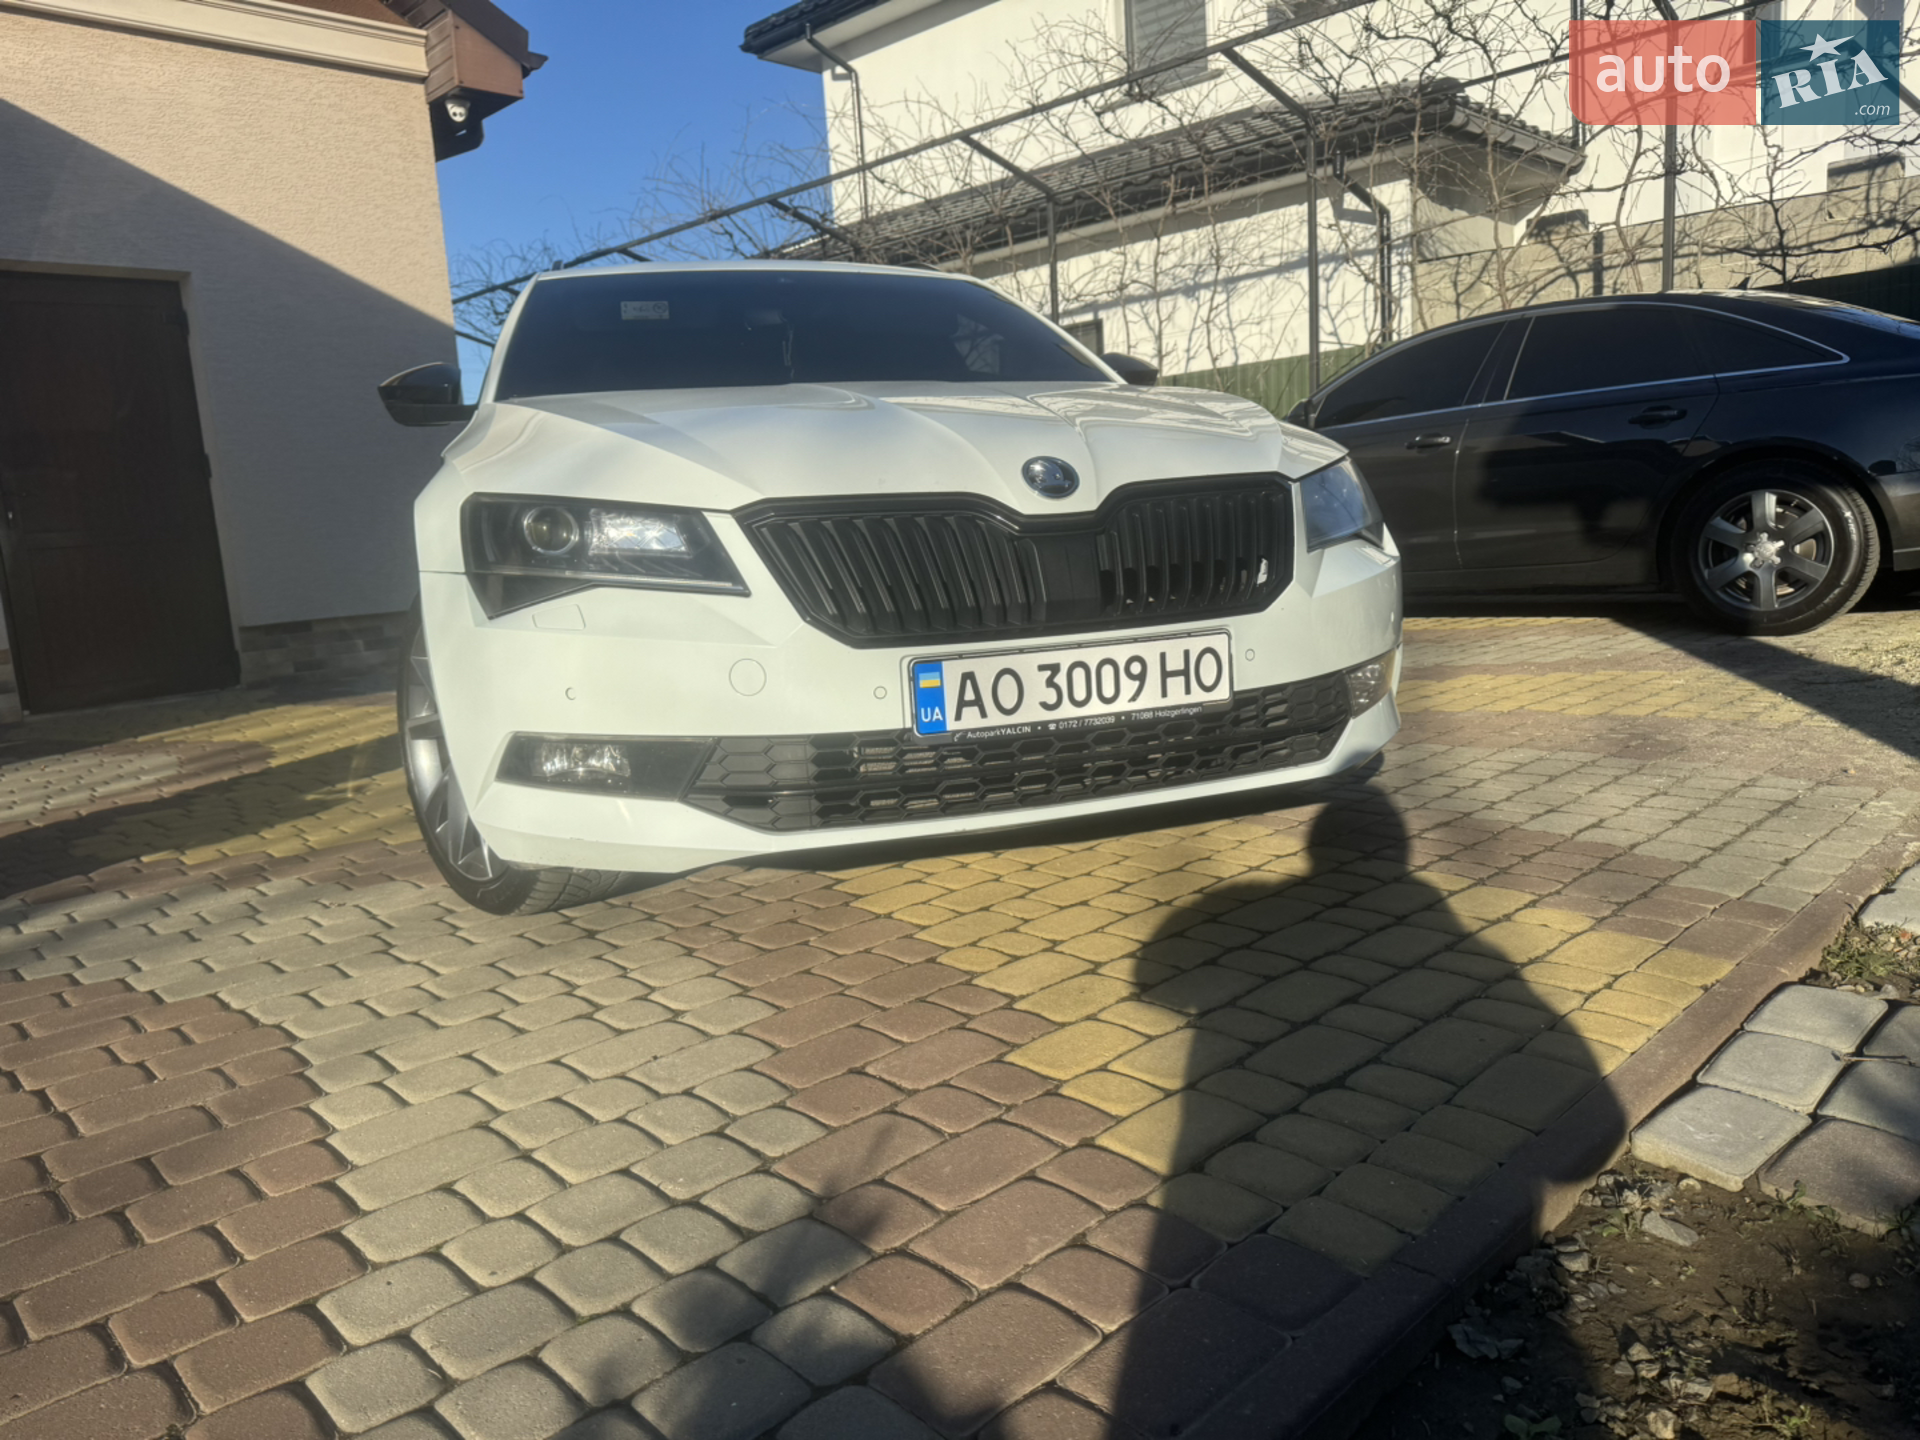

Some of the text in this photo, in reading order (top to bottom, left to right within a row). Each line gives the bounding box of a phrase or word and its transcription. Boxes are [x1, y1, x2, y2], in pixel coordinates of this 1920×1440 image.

[954, 646, 1223, 722] AO 3009 HO
[921, 706, 944, 723] UA
[1058, 720, 1078, 730] 0172
[1154, 706, 1203, 718] Holzgerlingen
